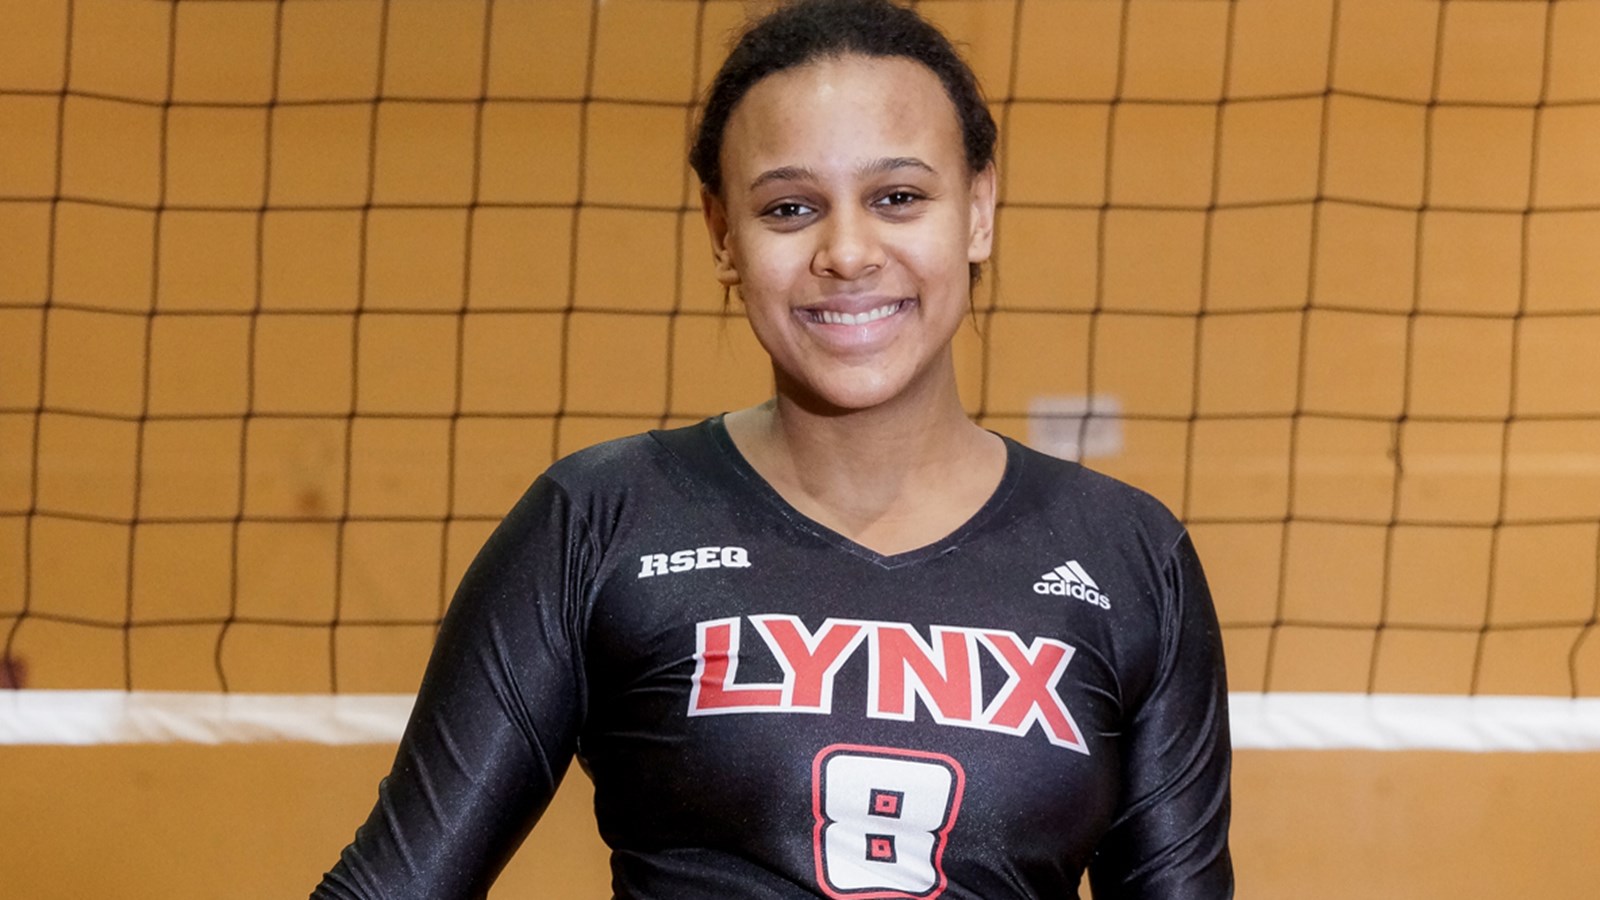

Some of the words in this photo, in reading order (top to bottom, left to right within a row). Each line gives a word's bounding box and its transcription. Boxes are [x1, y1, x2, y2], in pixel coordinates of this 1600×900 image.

[638, 546, 752, 579] RSEQ
[1033, 579, 1111, 610] adidas
[687, 613, 1090, 755] LYNX
[812, 743, 965, 900] 8
